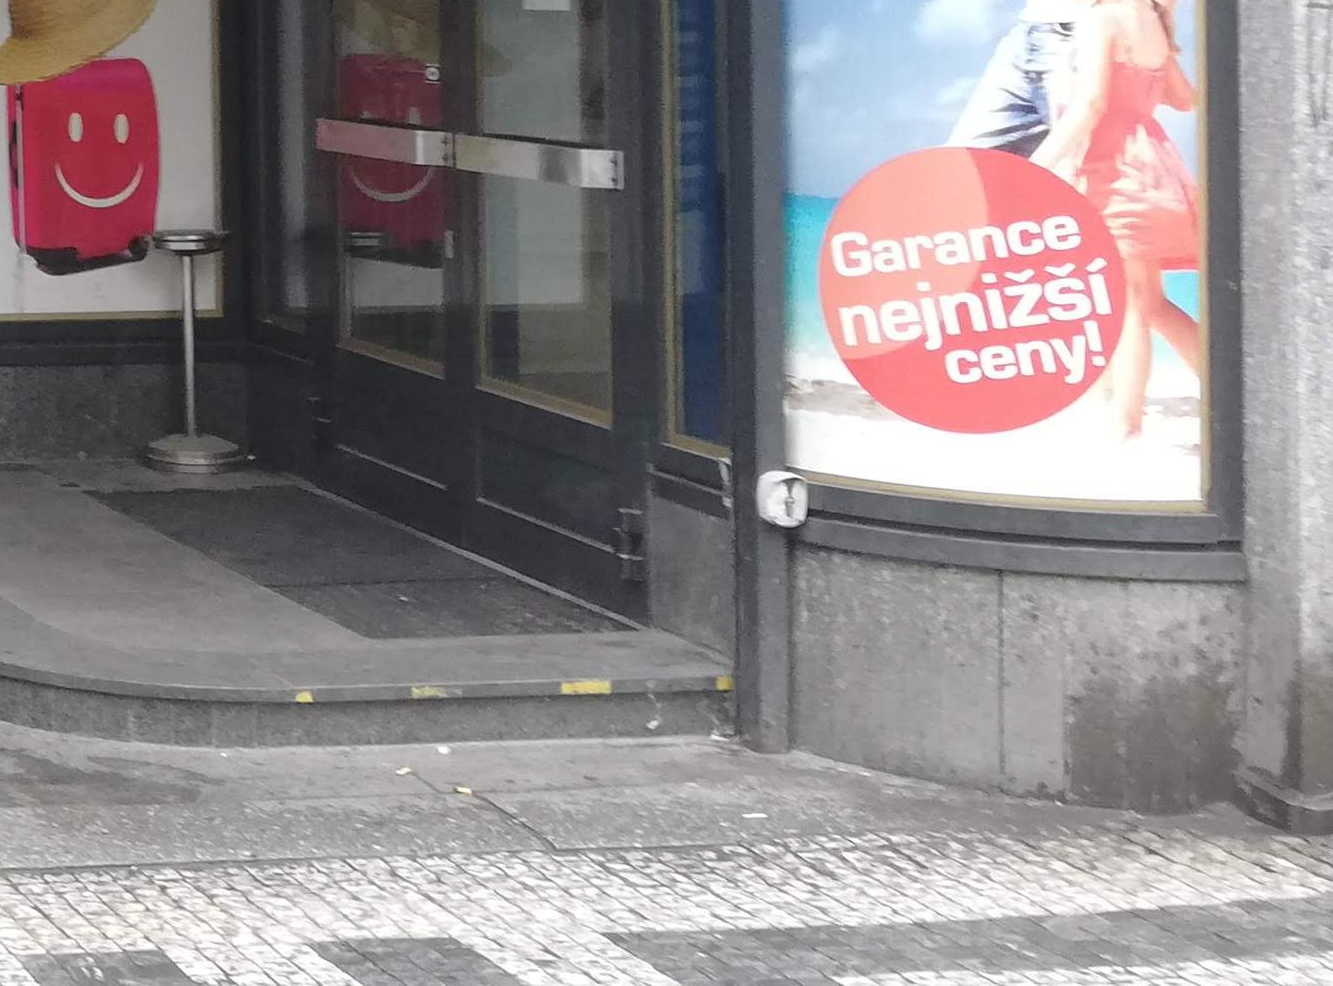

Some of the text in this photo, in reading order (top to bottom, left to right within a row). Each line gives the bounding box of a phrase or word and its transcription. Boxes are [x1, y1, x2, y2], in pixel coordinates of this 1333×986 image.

[830, 215, 1081, 277] Garance
[838, 258, 1113, 351] nejnižší
[945, 320, 1107, 385] ceny!
